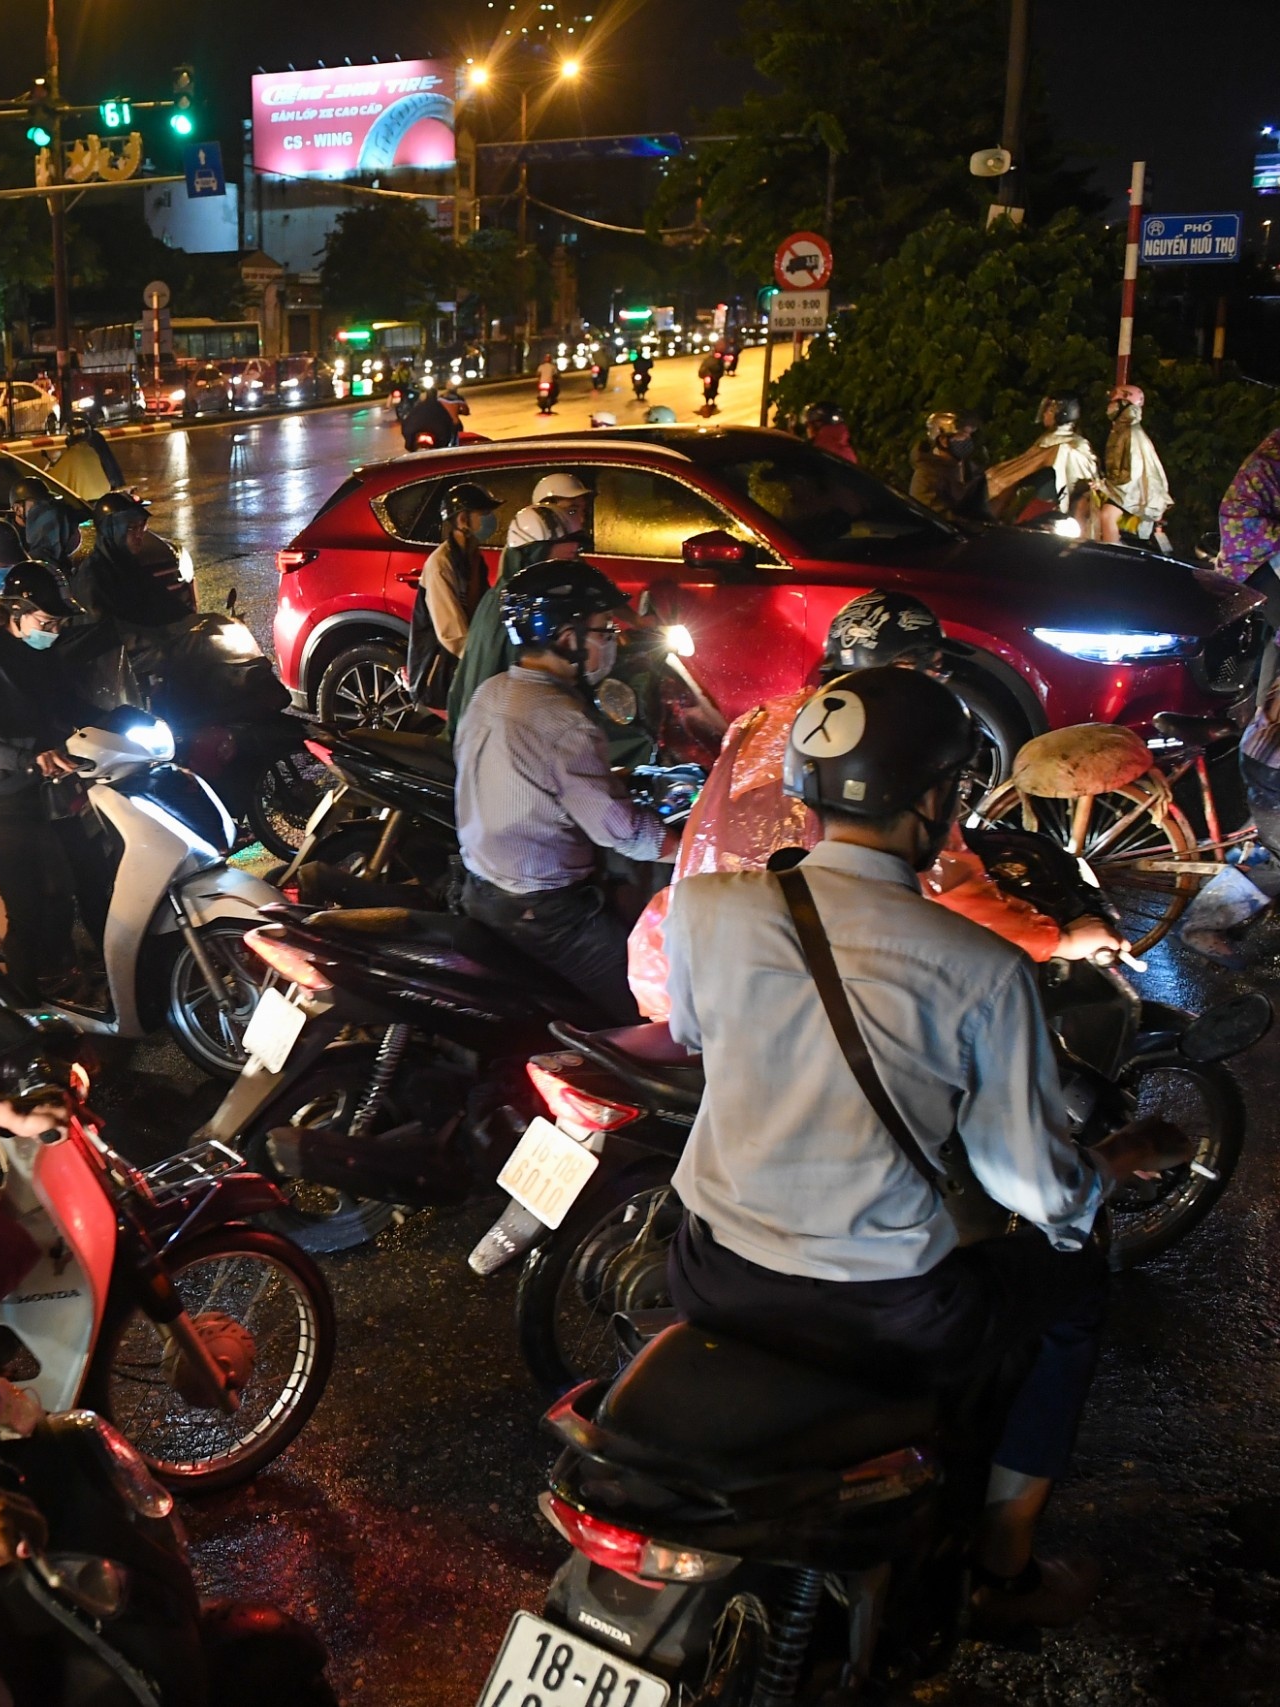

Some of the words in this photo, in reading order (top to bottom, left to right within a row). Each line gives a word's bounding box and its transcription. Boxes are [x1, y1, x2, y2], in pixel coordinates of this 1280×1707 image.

[384, 75, 443, 94] TIRE
[104, 102, 132, 128] 61
[334, 107, 359, 118] CAO
[283, 135, 302, 150] CS
[313, 131, 353, 148] WING
[1184, 220, 1213, 233] PHỐ
[1144, 234, 1187, 256] NGUYỄN
[1215, 236, 1236, 257] THỌ
[511, 1159, 564, 1215] 6010
[16, 1289, 81, 1304] HONDA
[578, 1611, 632, 1646] HONDA
